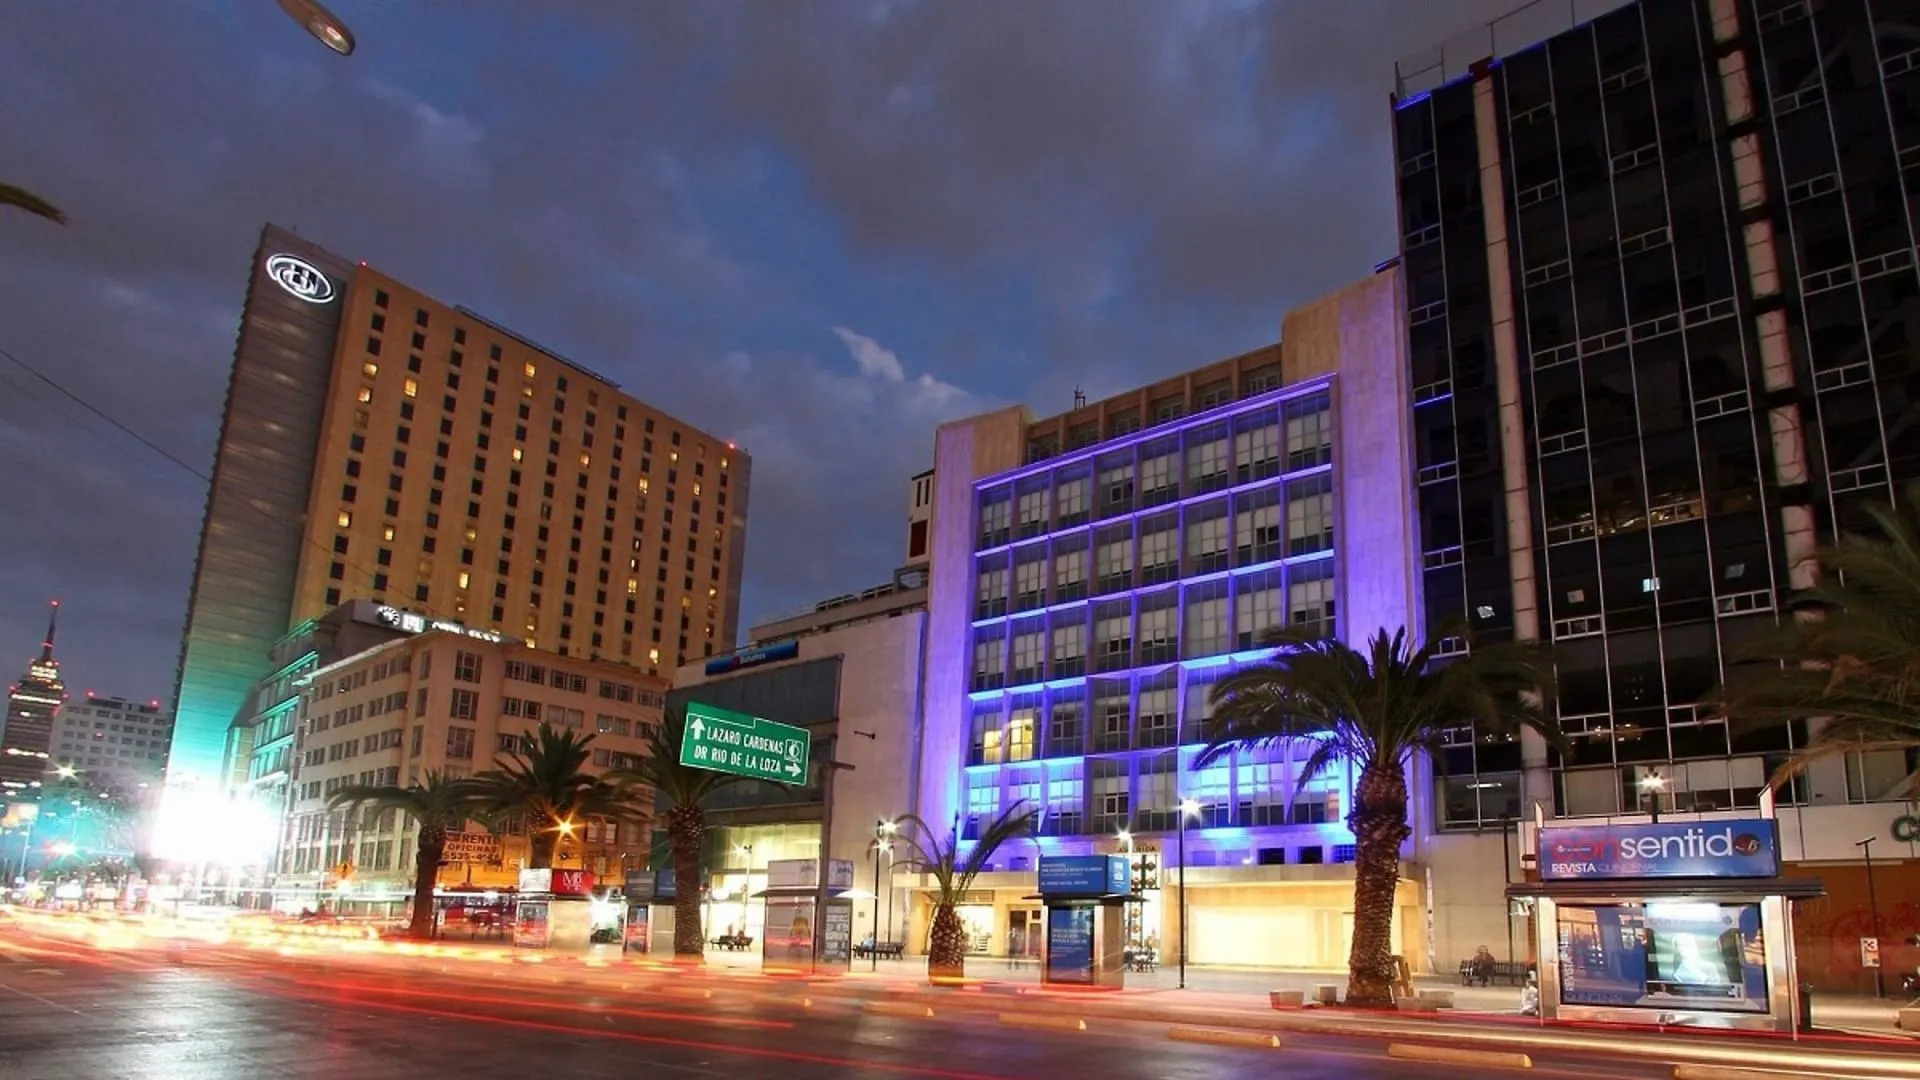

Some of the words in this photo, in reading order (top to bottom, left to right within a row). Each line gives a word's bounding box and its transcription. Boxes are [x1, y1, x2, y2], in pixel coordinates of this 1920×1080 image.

[706, 725, 741, 745] LAZARO
[743, 734, 784, 754] CARDENAS
[694, 745, 708, 760] DR
[711, 747, 728, 763] RIO
[730, 752, 742, 766] DE
[745, 754, 757, 769] LA
[759, 758, 781, 773] LOZA
[1551, 862, 1597, 873] REVISTA
